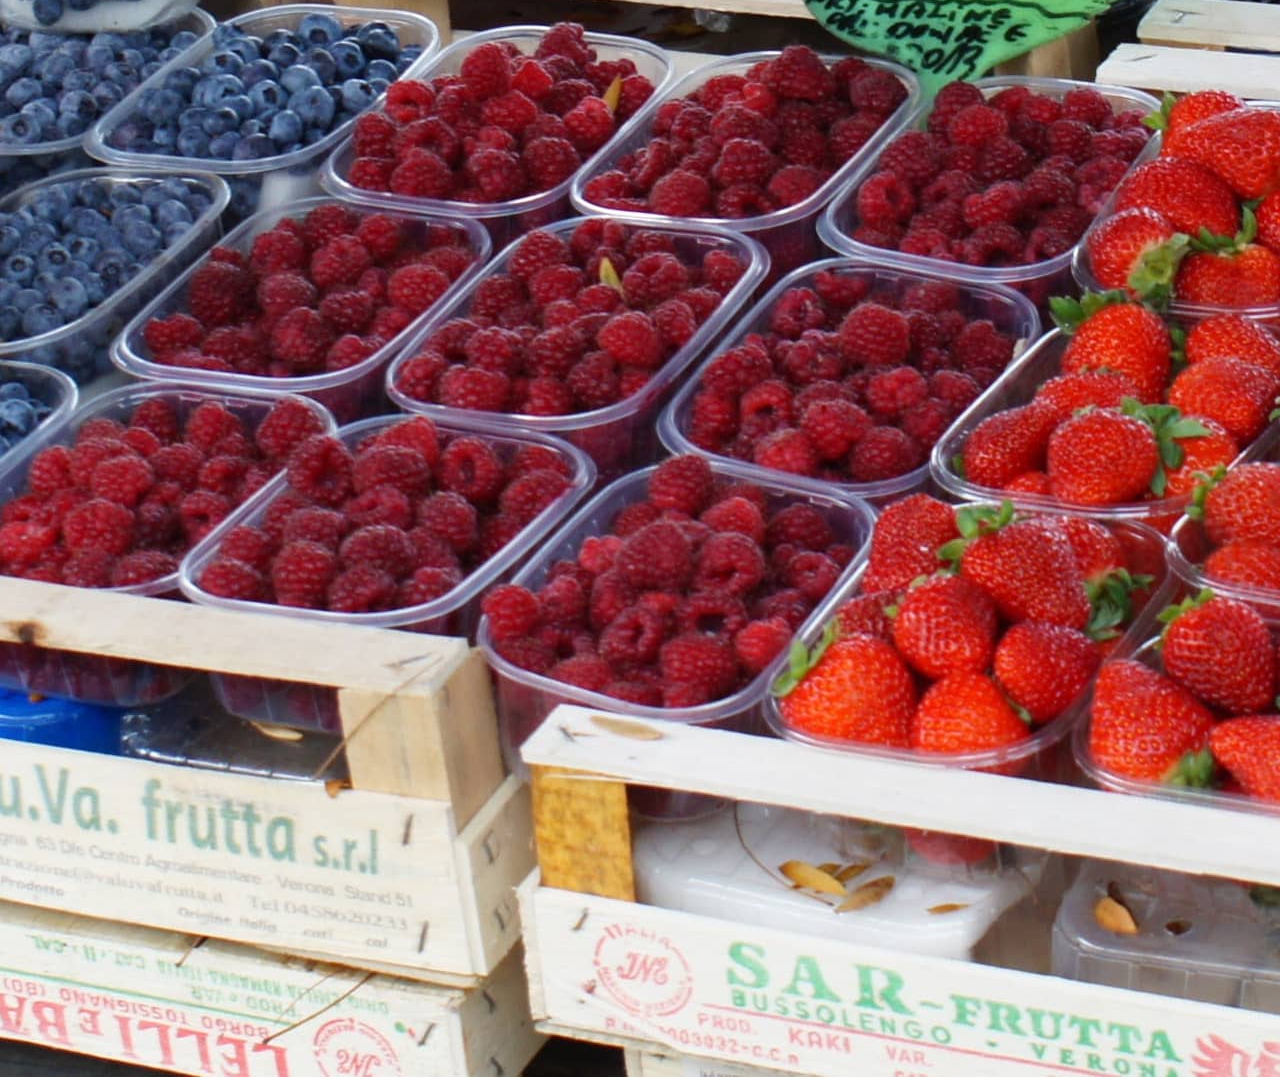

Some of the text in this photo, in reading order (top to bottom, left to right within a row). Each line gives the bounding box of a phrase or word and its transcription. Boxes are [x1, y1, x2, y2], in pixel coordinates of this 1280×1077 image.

[143, 777, 297, 863] frutta
[59, 987, 188, 1025] TOSSIGNANO
[731, 990, 953, 1045] BUSSOLENGO
[787, 1026, 853, 1054] KAKI
